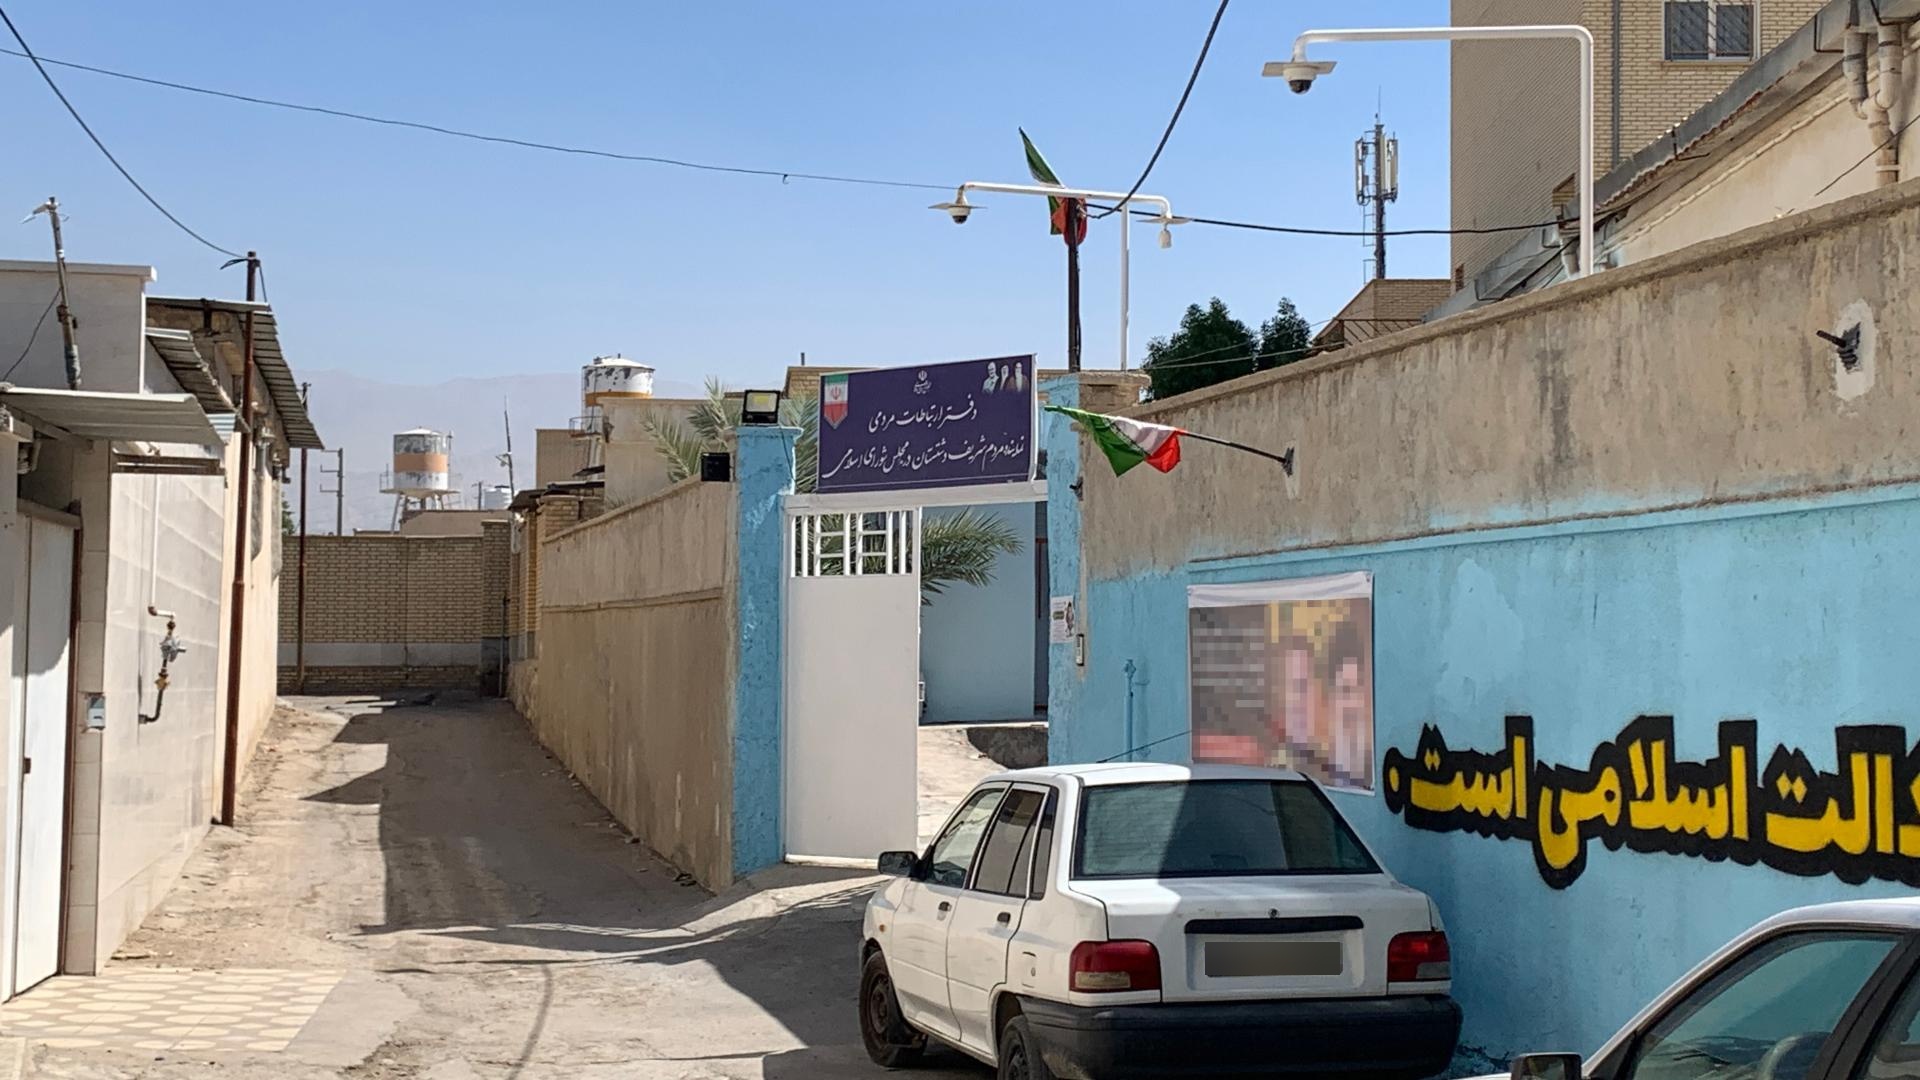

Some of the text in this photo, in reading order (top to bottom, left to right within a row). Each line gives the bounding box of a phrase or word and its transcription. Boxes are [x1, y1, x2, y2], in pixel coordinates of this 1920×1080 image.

[868, 393, 978, 433] دفتر ارتباطات مردمی
[821, 448, 863, 479] اسلامی
[863, 446, 888, 469] شورای
[911, 438, 948, 471] دشتستان
[948, 434, 988, 465] شریف
[981, 443, 1004, 472] مردم
[1536, 728, 1752, 878] اسلامی
